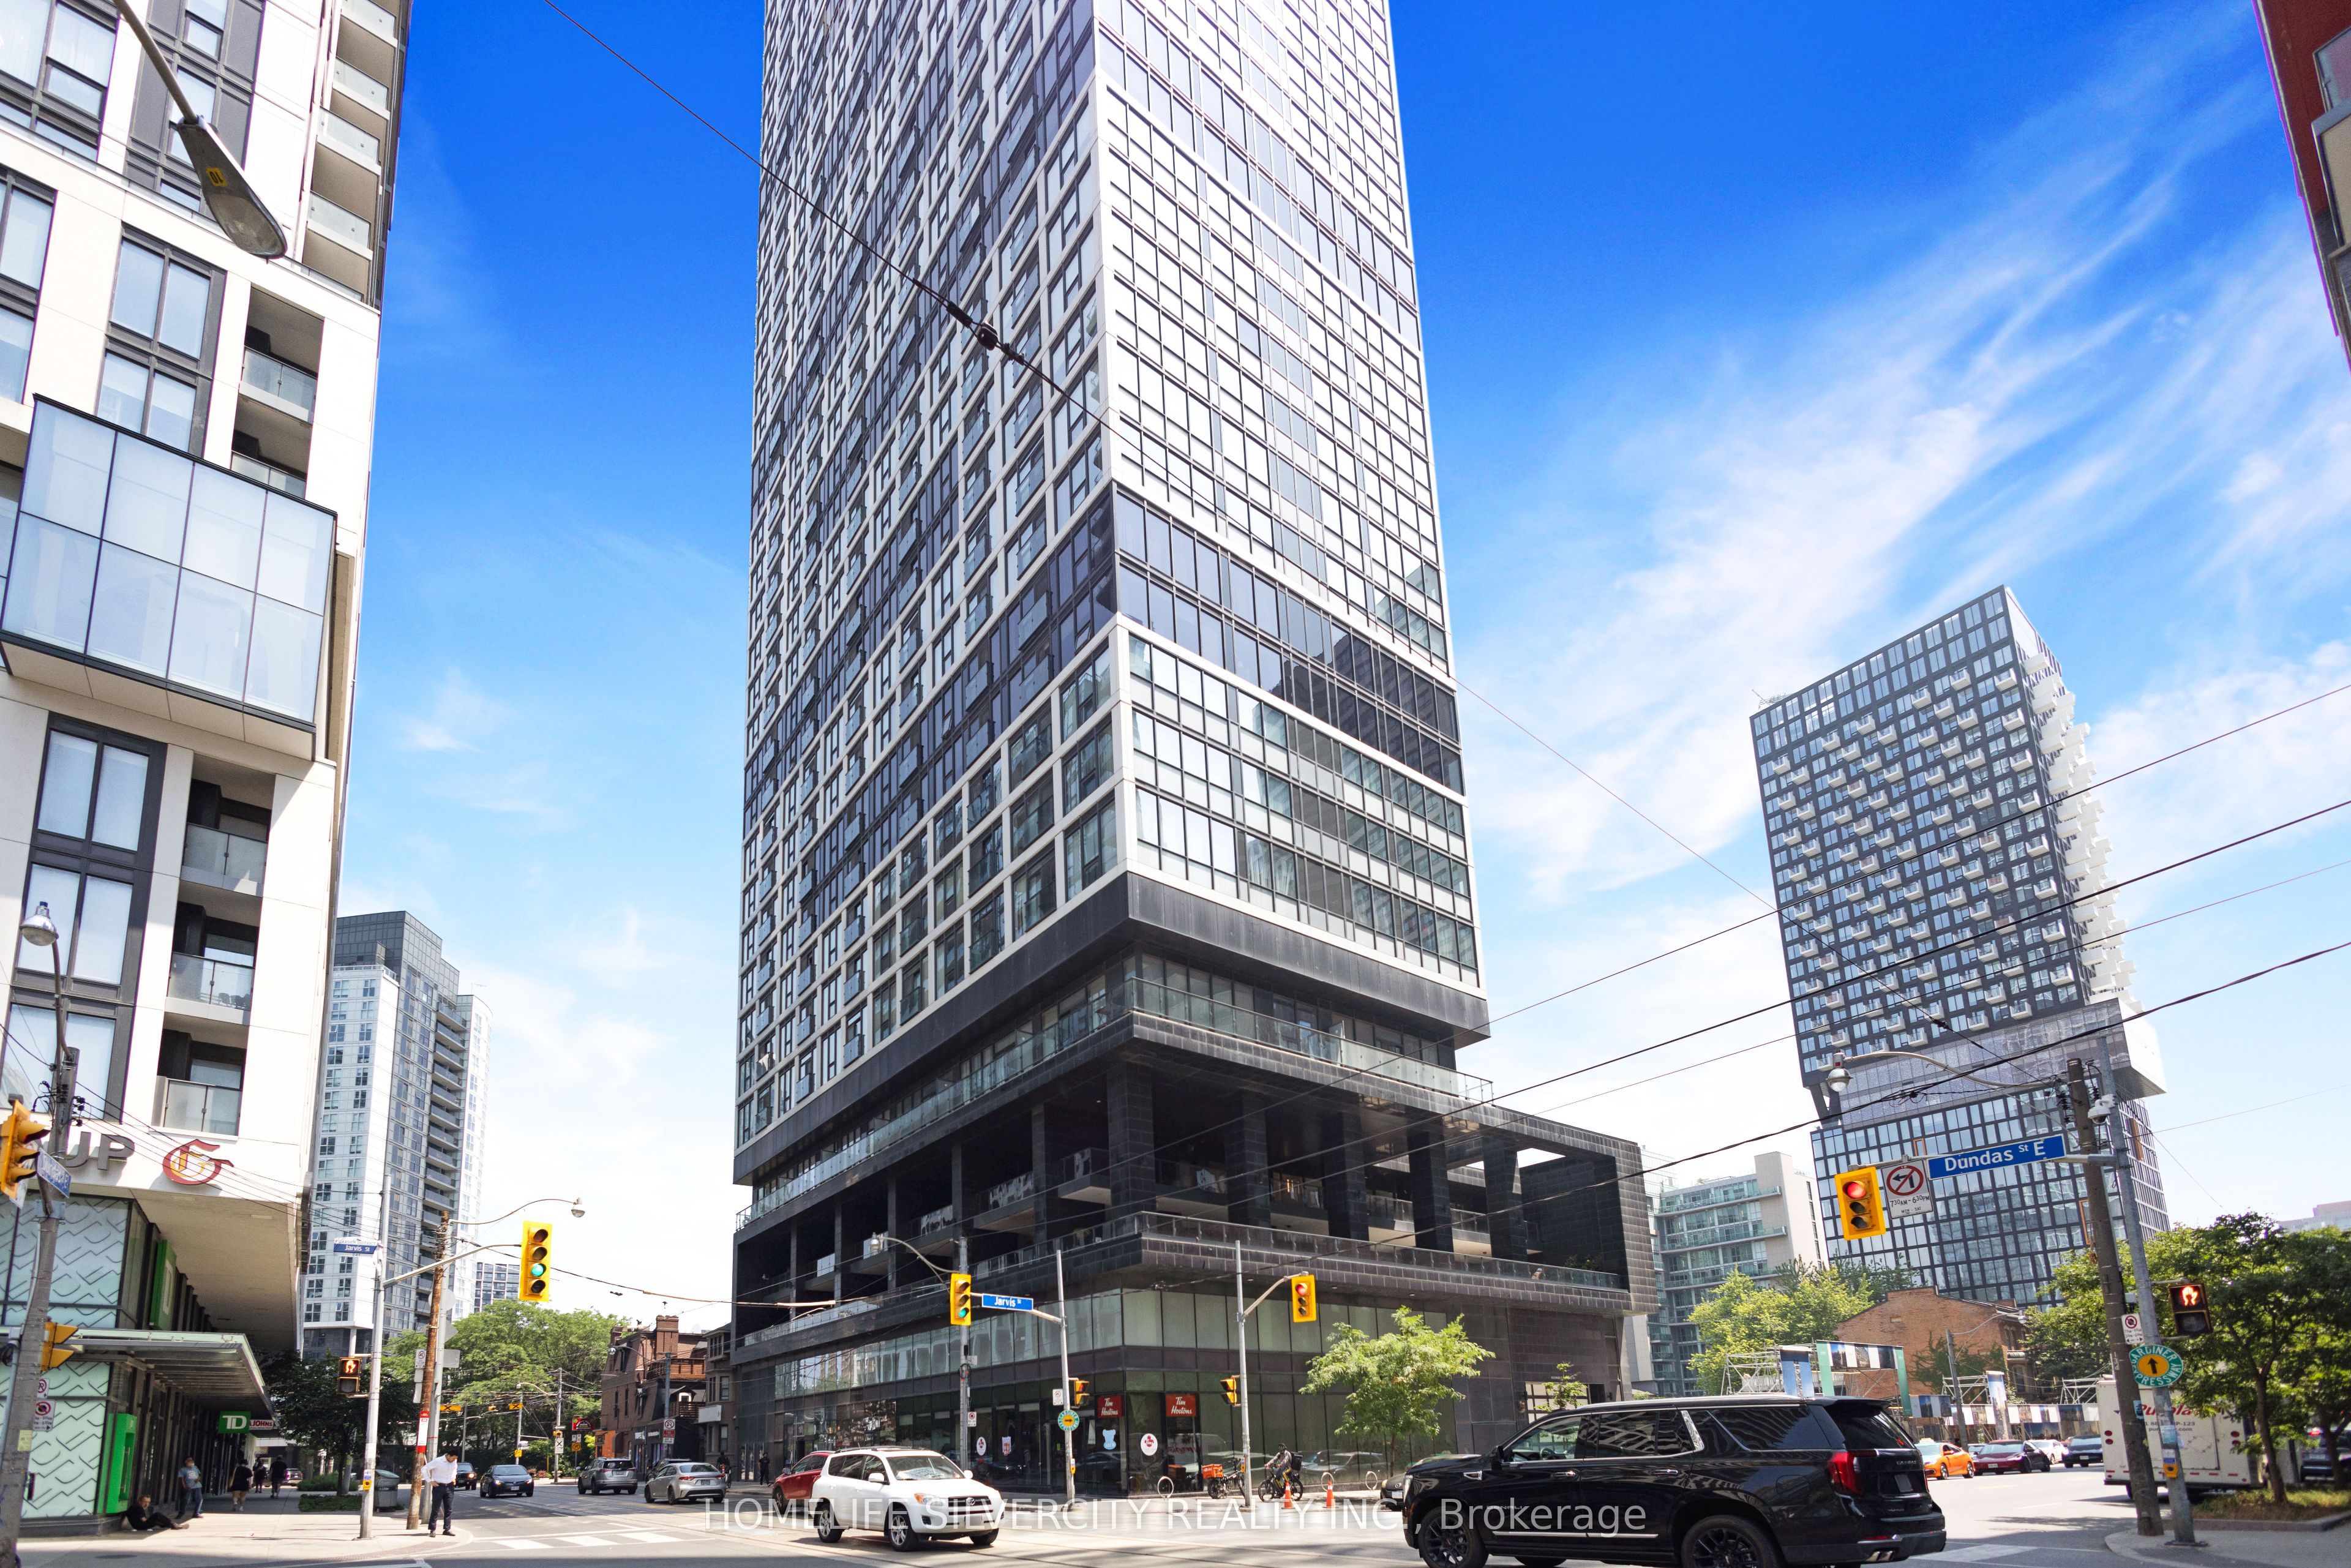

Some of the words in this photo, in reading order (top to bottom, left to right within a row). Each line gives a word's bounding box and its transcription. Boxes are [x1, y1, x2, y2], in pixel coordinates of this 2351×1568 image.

[1944, 1149, 2014, 1172] Dundas
[2033, 1141, 2045, 1156] E
[1890, 1199, 1908, 1207] 730AM
[994, 1297, 1016, 1307] Jarvis
[1104, 1398, 1113, 1406] Tim
[1176, 1397, 1186, 1405] Tim
[1101, 1407, 1118, 1416] Hortons
[1171, 1405, 1192, 1414] Hortons
[222, 1415, 247, 1430] TD
